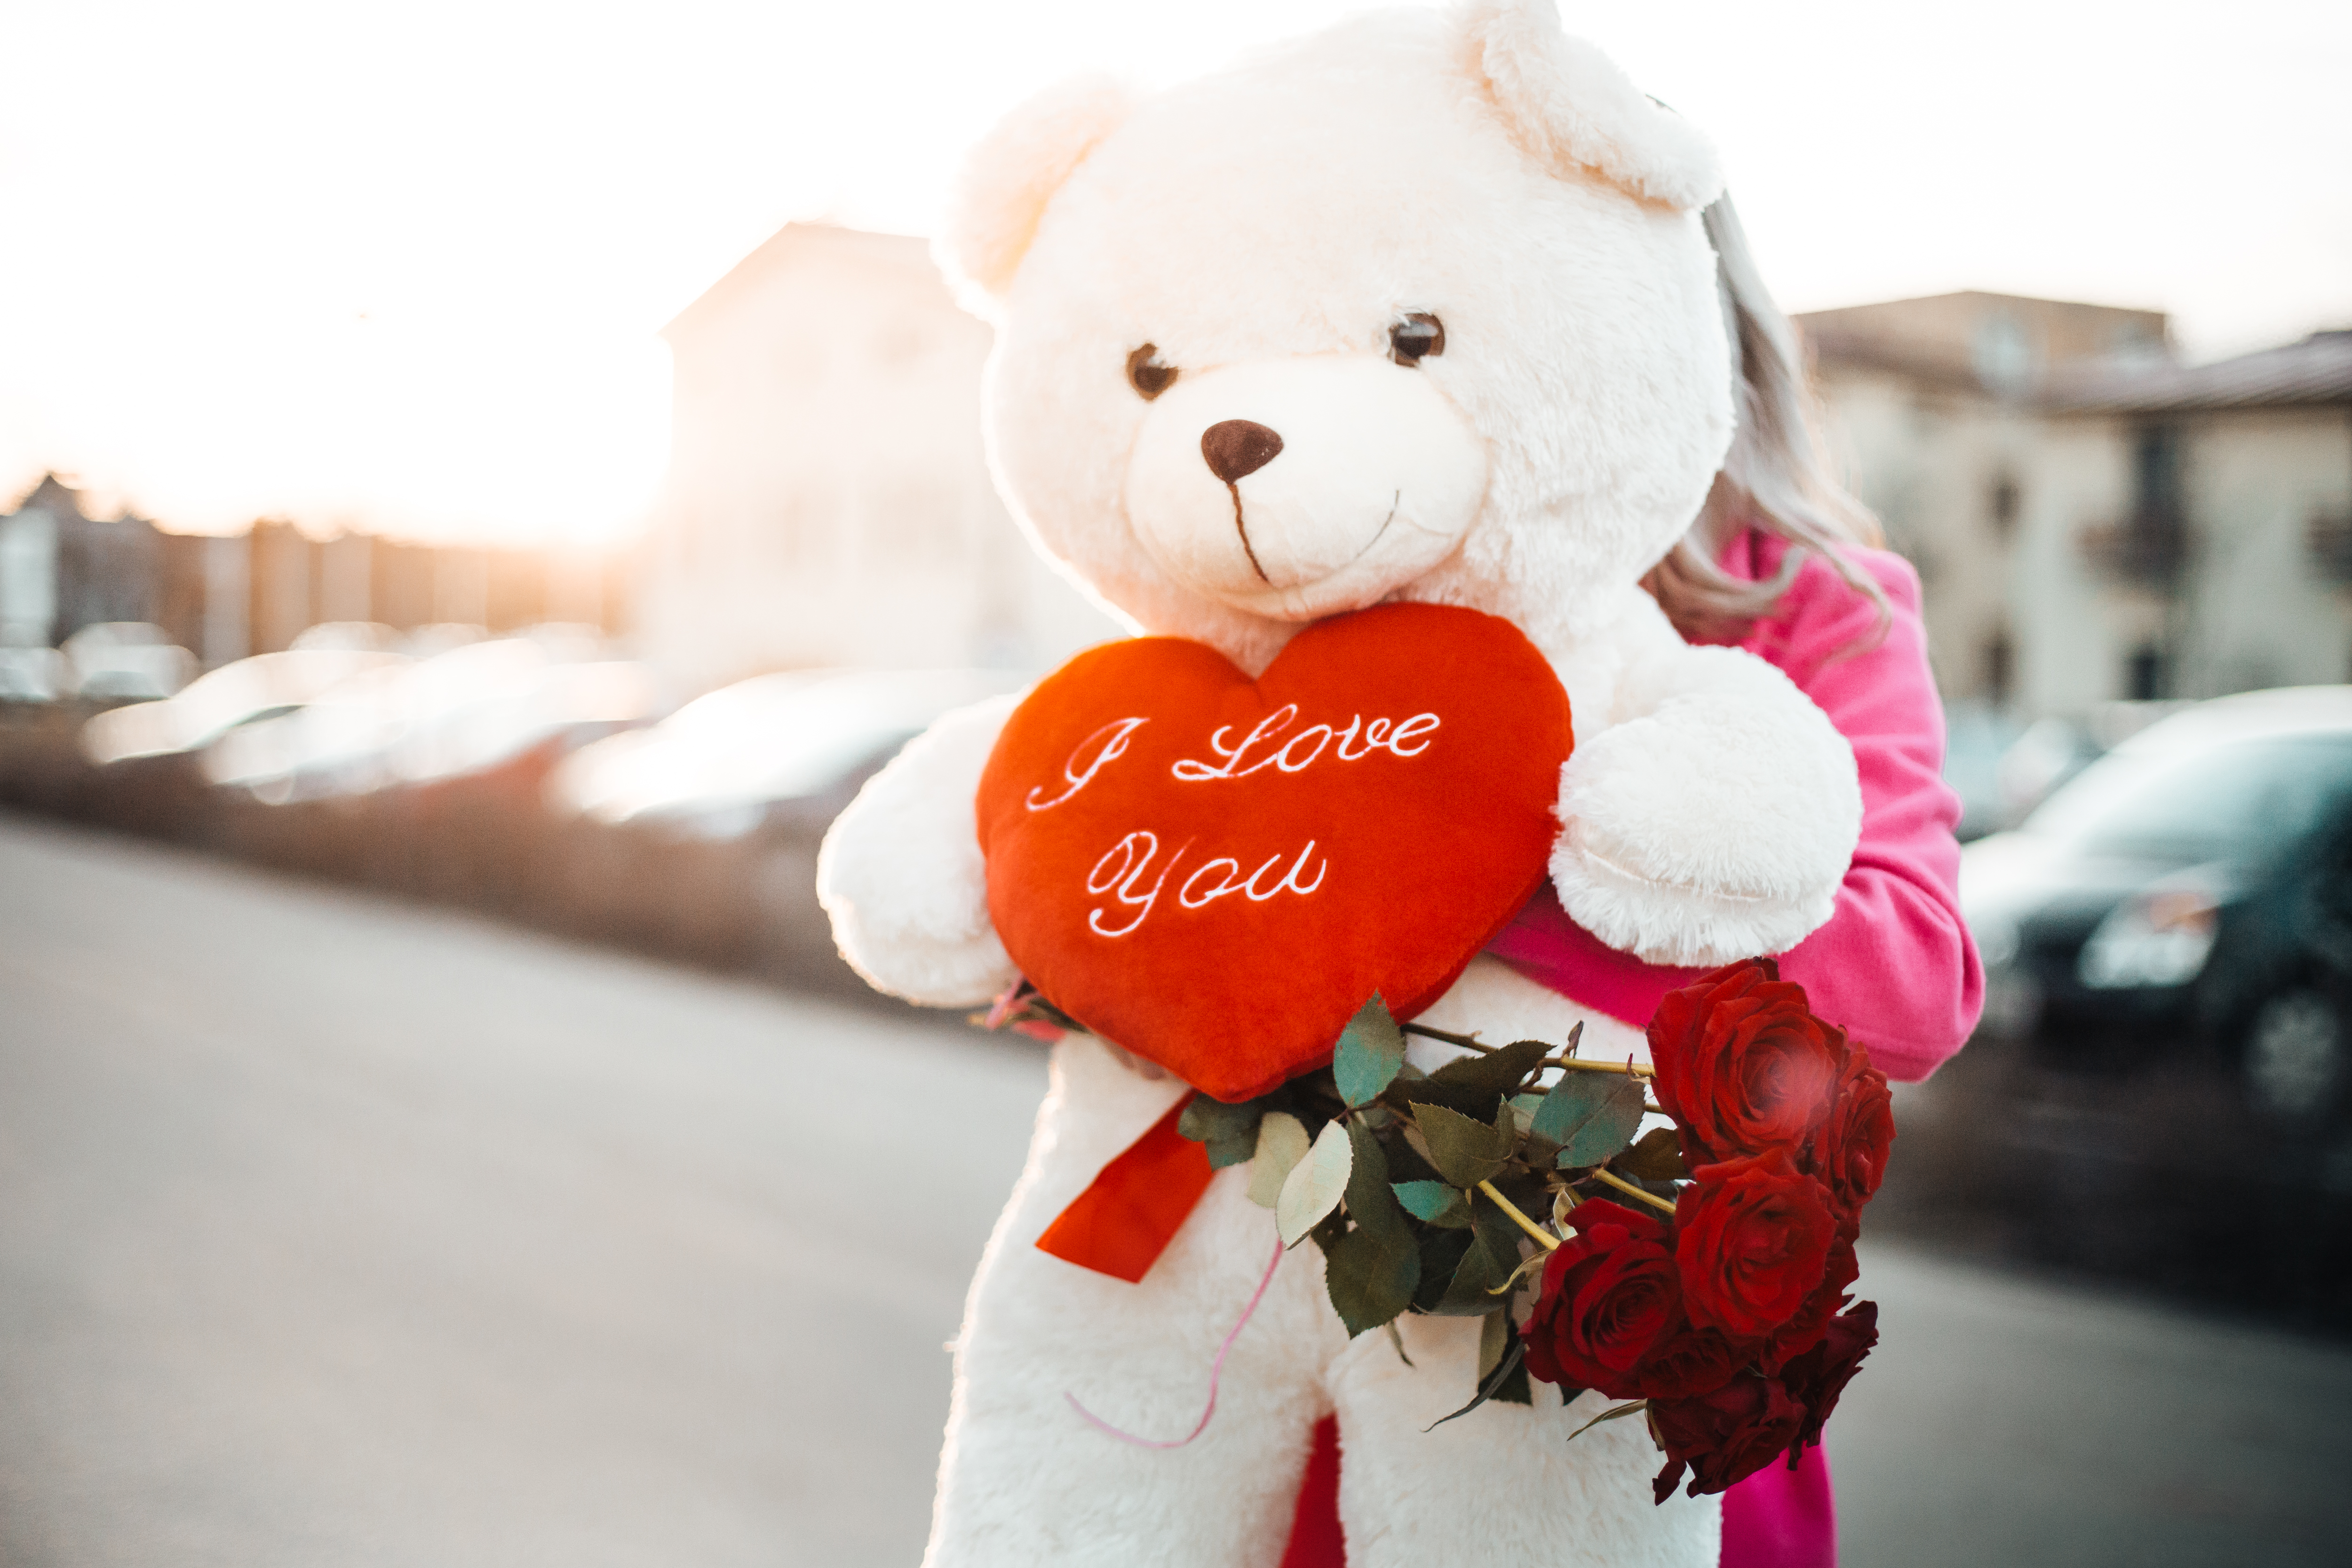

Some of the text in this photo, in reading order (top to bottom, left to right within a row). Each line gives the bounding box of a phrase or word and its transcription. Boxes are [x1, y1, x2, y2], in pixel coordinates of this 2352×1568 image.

[1026, 704, 1440, 811] I Love
[1088, 831, 1327, 937] You
